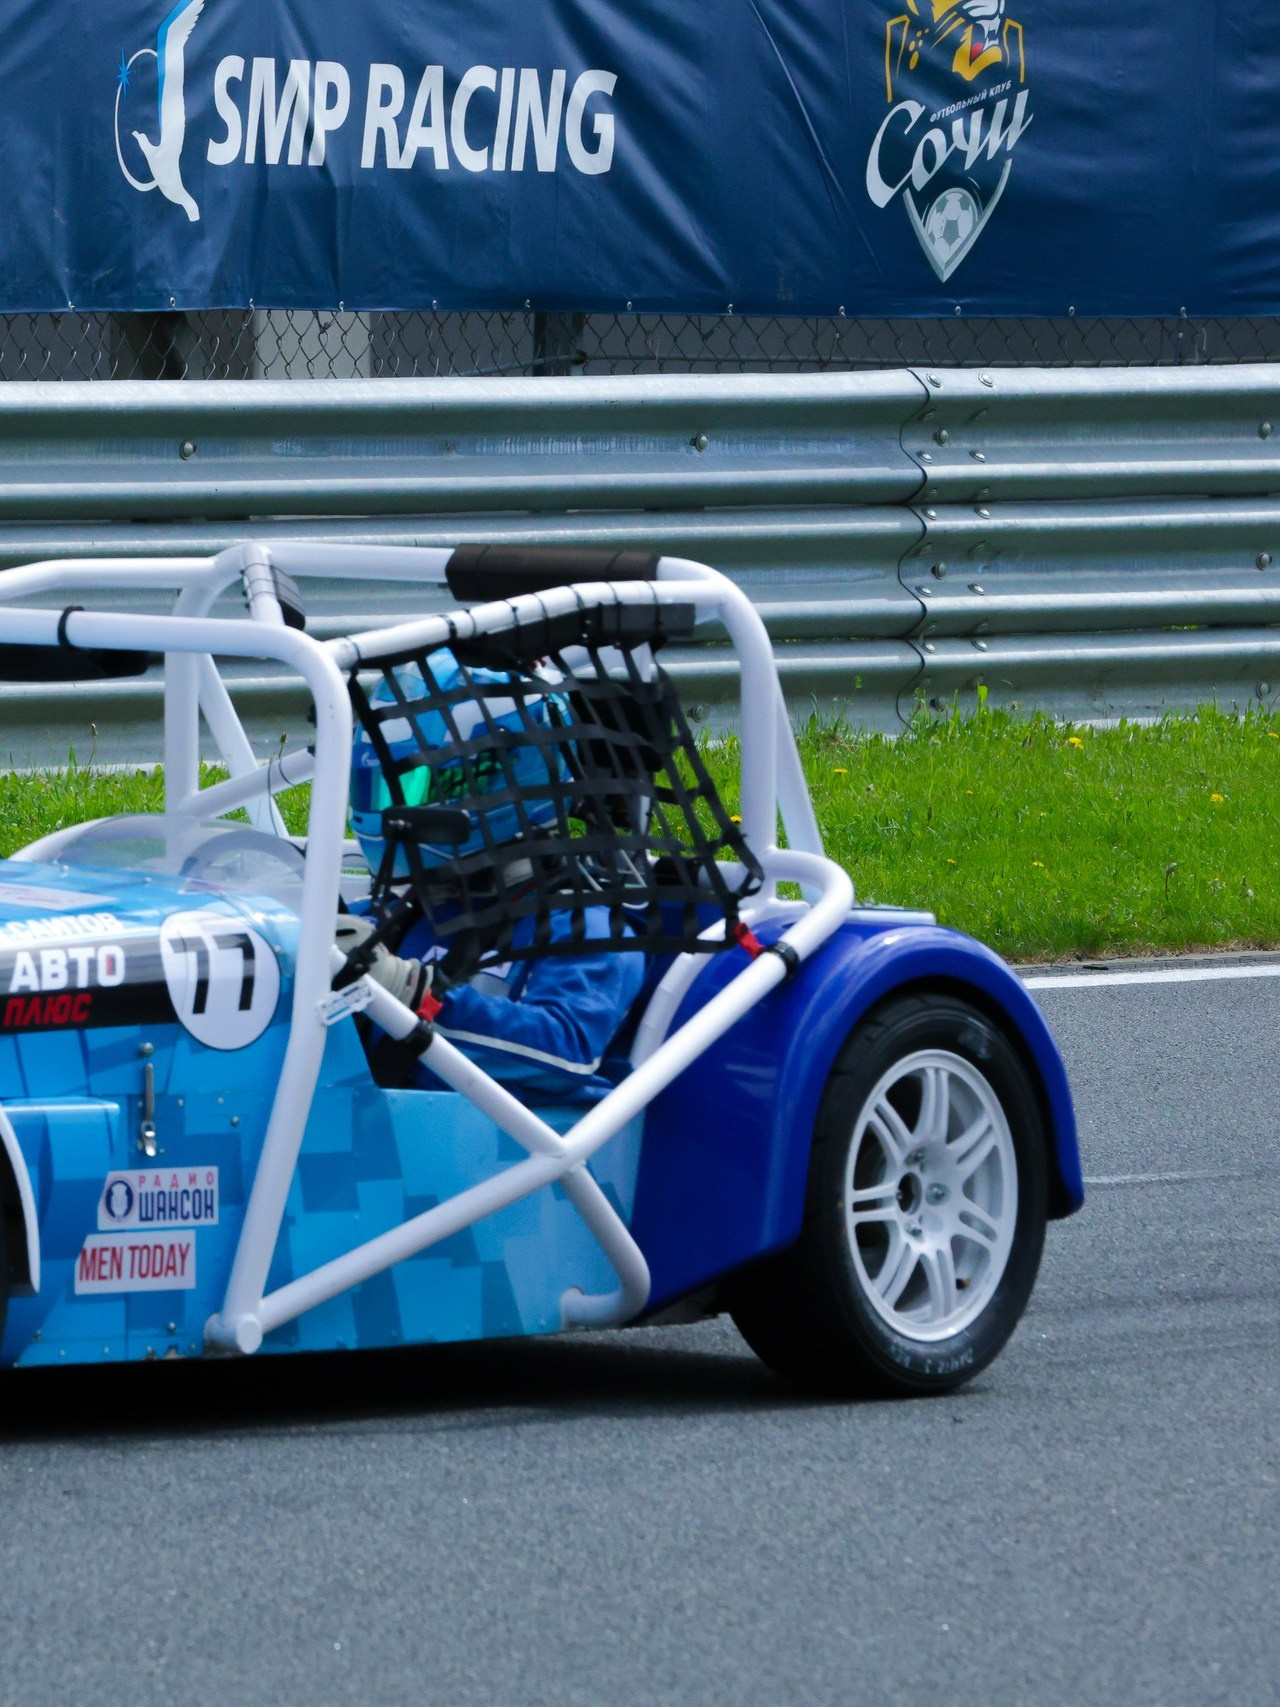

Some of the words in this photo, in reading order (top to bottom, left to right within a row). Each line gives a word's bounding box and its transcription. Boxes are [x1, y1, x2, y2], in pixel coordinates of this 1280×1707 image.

[206, 55, 351, 166] SMP
[361, 63, 618, 175] RACING
[930, 89, 988, 122] ФУТБОЛЬНЫЙ
[989, 80, 1012, 98] КЛУБ
[866, 88, 1034, 208] Сочи
[8, 945, 126, 993] АВТО
[168, 932, 256, 1015] 77
[3, 994, 92, 1028] ПЛЮС
[138, 1172, 215, 1188] РАДИО
[139, 1189, 215, 1222] ШАНСОН
[79, 1246, 124, 1282] MEN
[128, 1243, 191, 1279] TODAY
